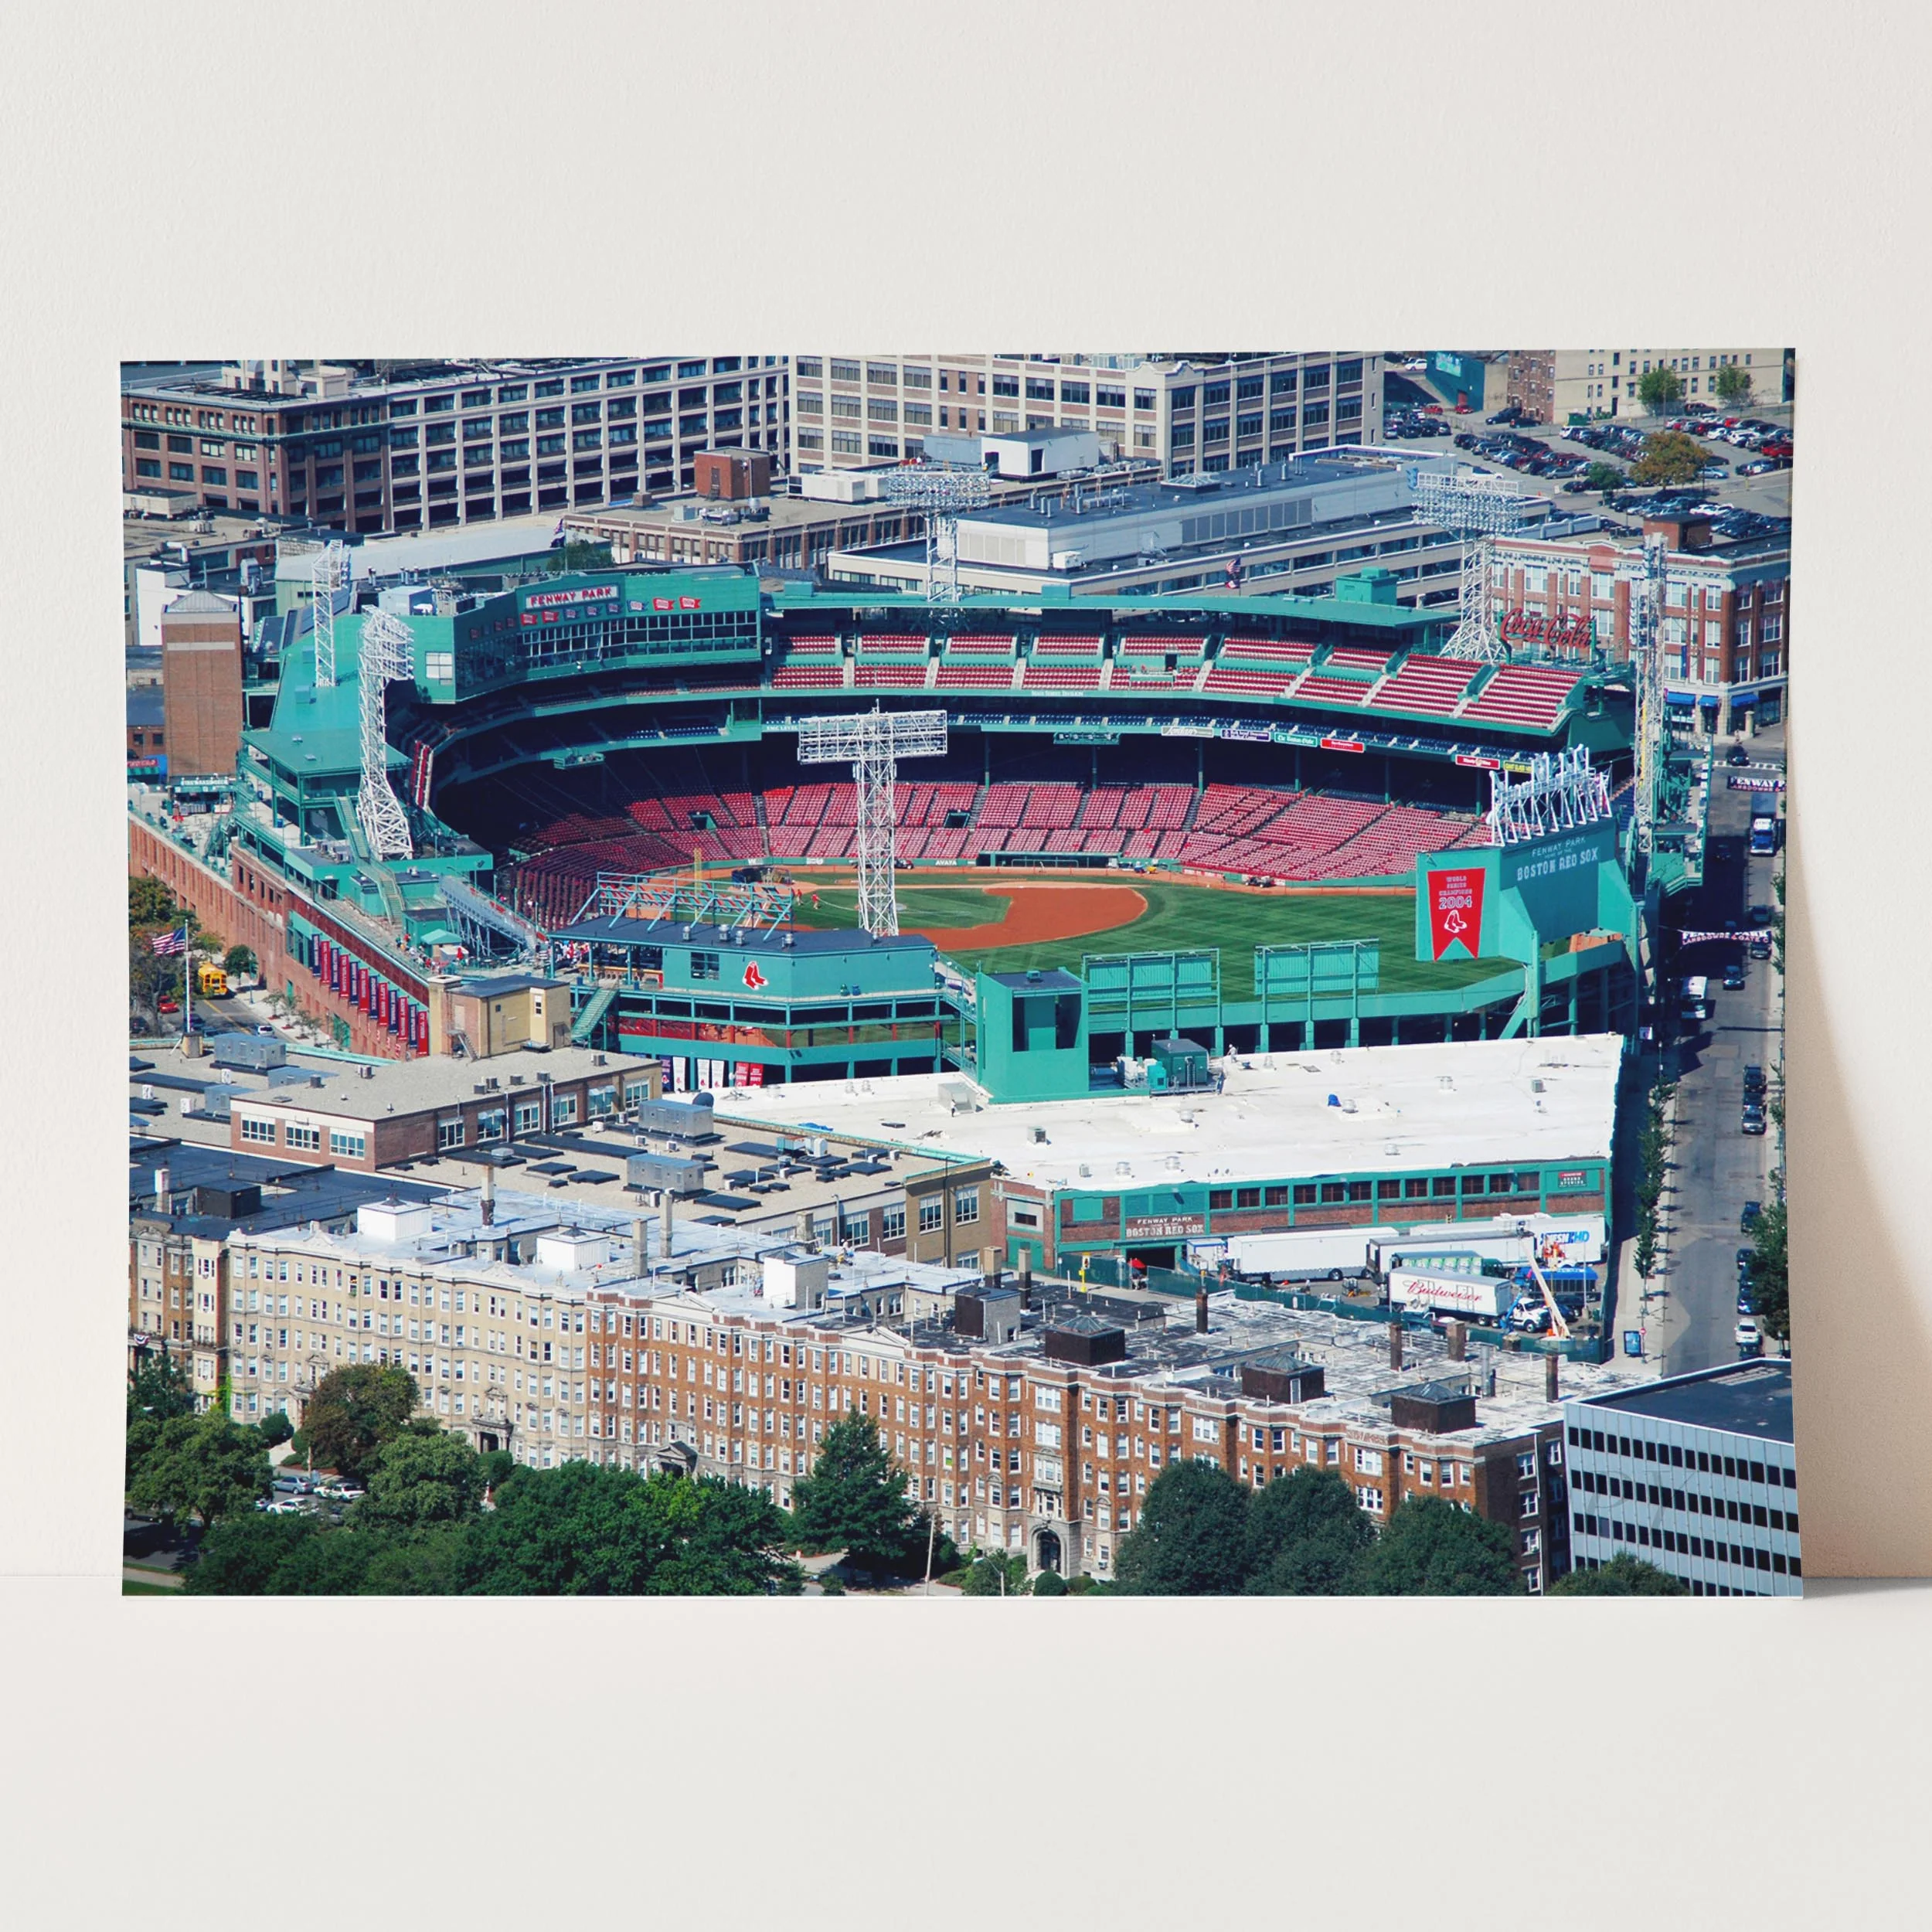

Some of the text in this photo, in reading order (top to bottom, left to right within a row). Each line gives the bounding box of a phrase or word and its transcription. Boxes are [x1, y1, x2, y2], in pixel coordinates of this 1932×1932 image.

[530, 586, 611, 607] FENWAY PARK
[1730, 776, 1774, 787] FENWAY
[1532, 836, 1586, 857] FENWAY PARK
[1517, 846, 1599, 881] BOSTON RED SOX
[1438, 895, 1472, 910] 2004
[1126, 1226, 1163, 1237] BOSTON
[1165, 1225, 1184, 1236] RED
[1185, 1223, 1204, 1234] SOX
[1406, 1281, 1483, 1301] Budweiser
